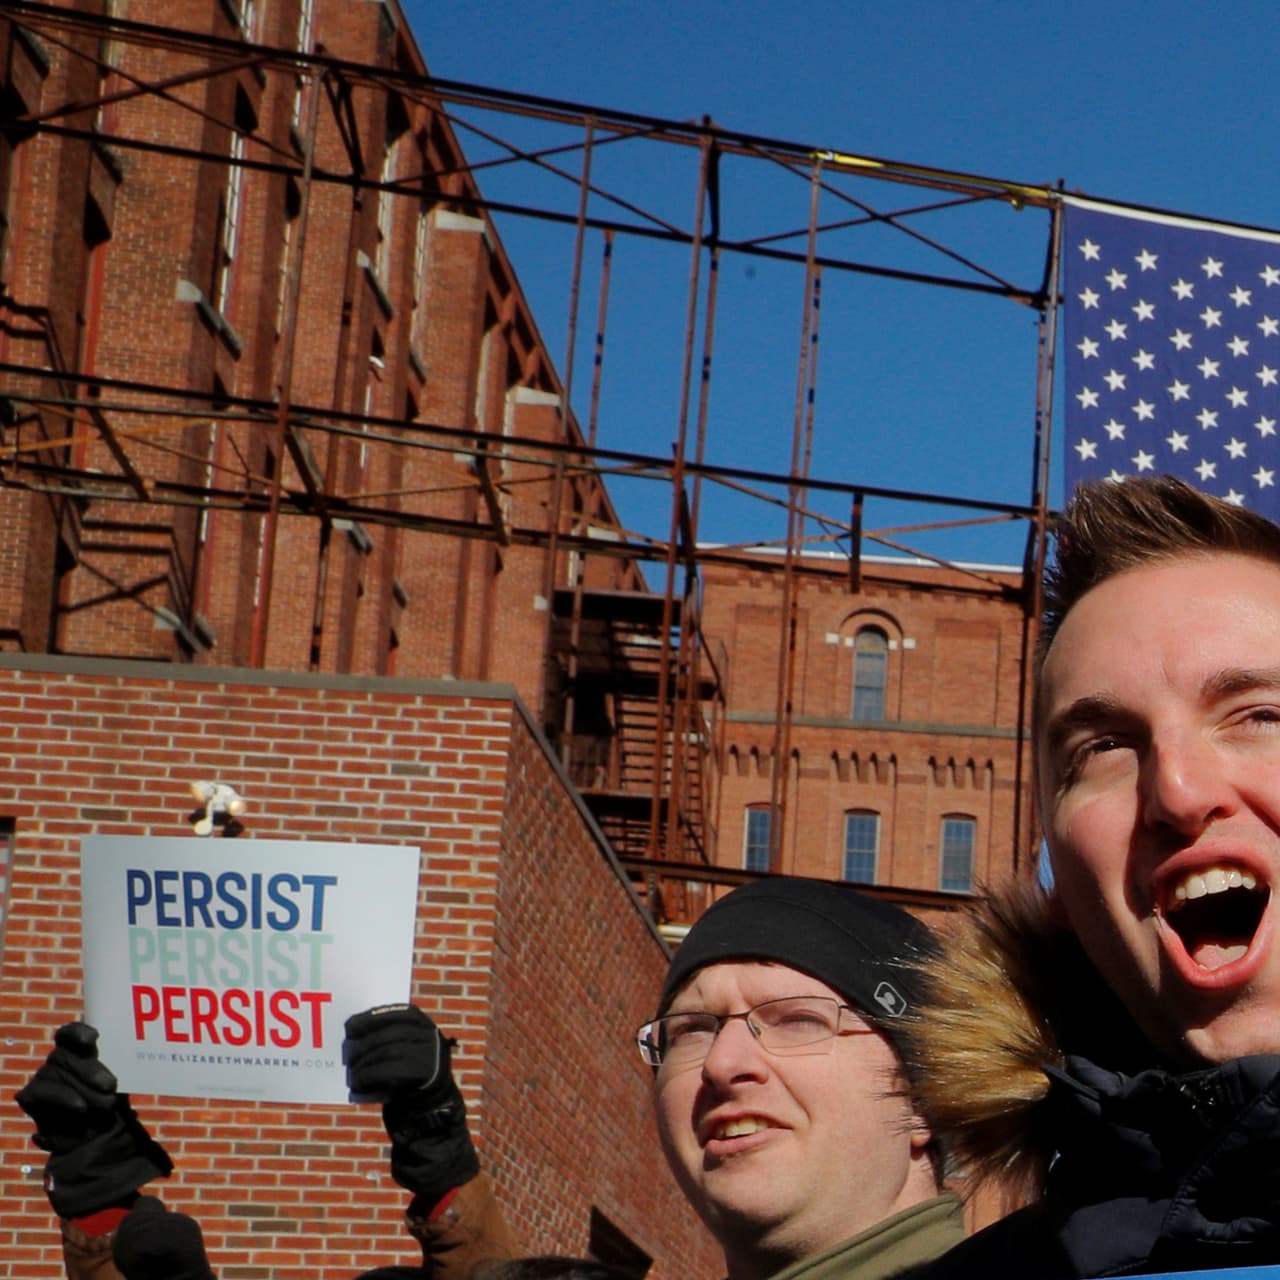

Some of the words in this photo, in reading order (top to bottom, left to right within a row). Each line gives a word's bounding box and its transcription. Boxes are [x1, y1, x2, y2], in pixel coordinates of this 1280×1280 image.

[126, 869, 338, 932] PERSIST
[128, 927, 334, 990] PERSIST
[131, 984, 332, 1049] PERSIST
